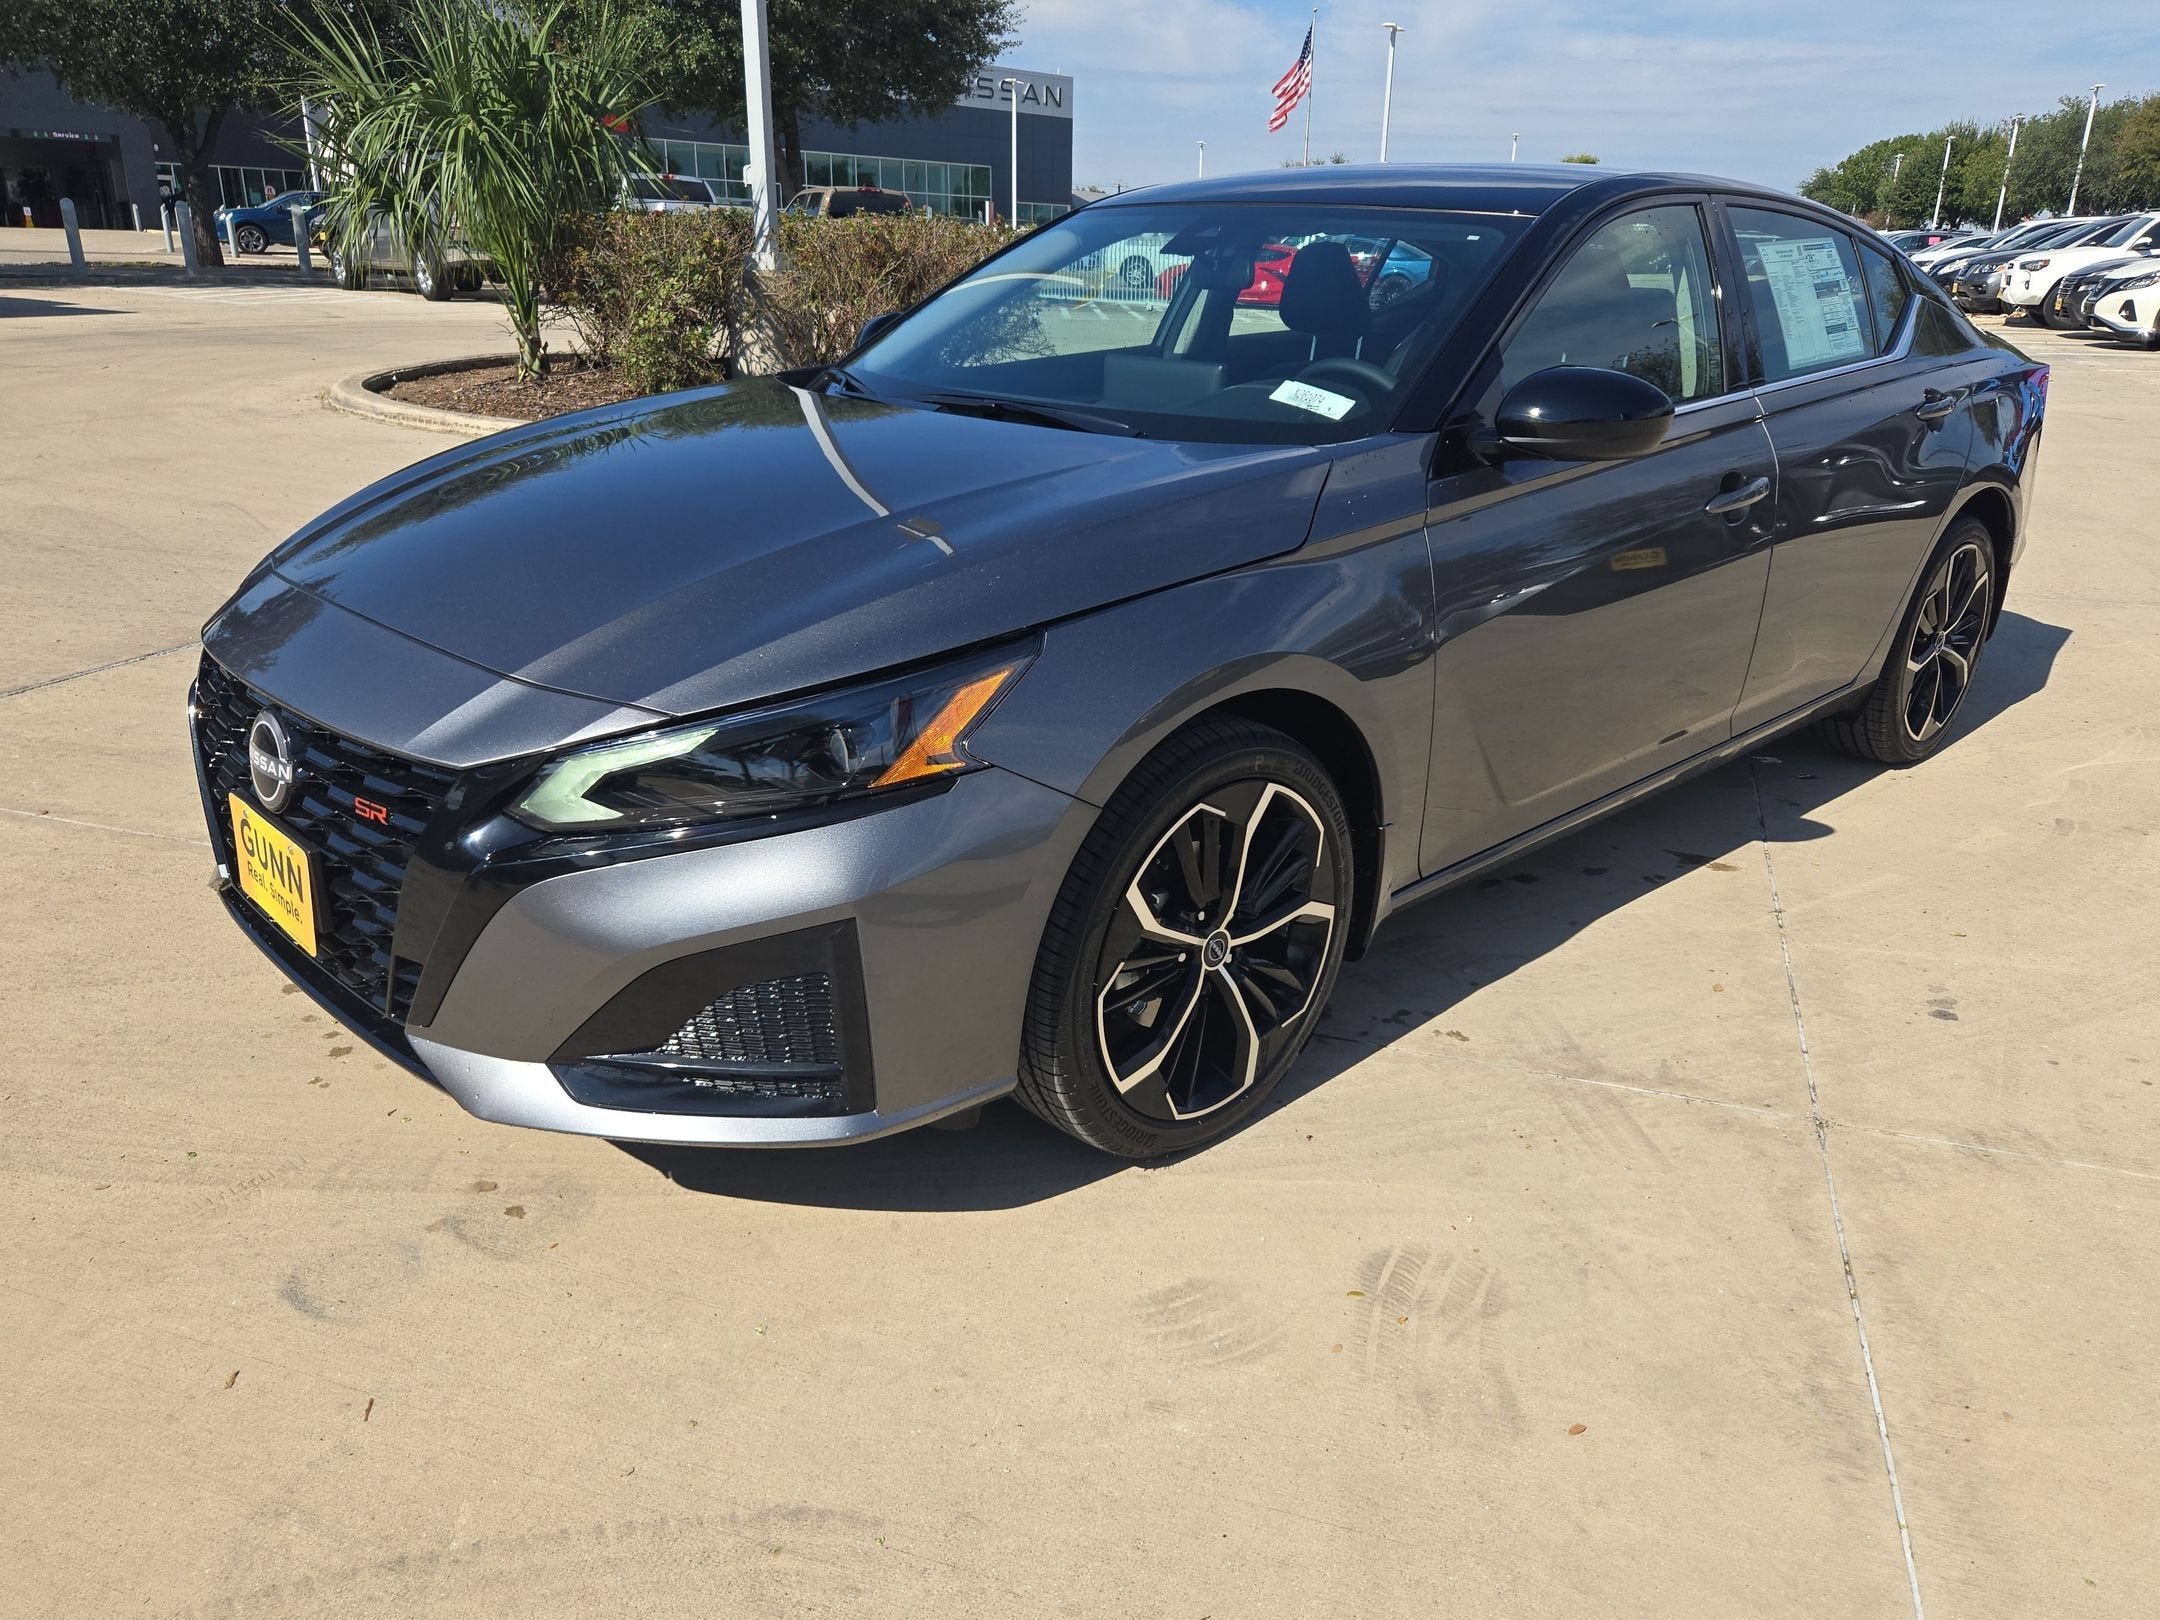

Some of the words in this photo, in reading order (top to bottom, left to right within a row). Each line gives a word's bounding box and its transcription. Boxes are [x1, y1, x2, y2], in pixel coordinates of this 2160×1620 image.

[965, 77, 1062, 107] ISSAN
[354, 796, 388, 825] SR
[1292, 761, 1347, 837] BRIDGESTONE
[240, 818, 304, 903] GUNN
[247, 860, 268, 892] Real.
[269, 882, 303, 924] Simple.
